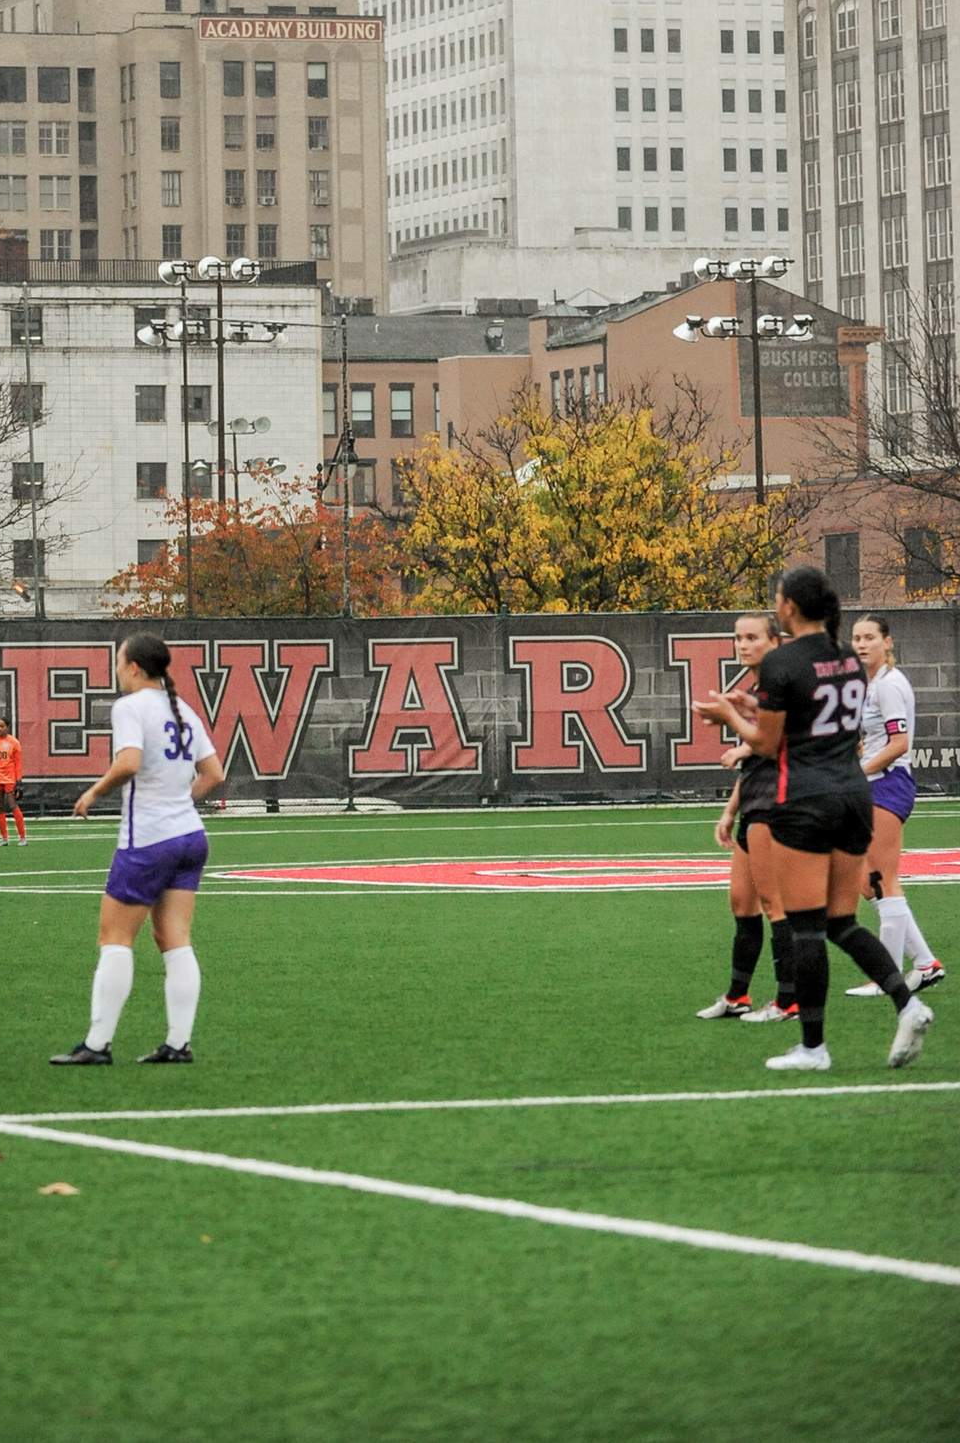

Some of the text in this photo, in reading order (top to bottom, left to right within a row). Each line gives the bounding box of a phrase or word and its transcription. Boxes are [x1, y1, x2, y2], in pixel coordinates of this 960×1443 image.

[205, 21, 377, 40] ACADEMY BUILDING
[761, 349, 838, 367] BUSINESS
[783, 371, 849, 388] COLLEGE
[810, 679, 866, 737] 29
[163, 720, 194, 761] 32
